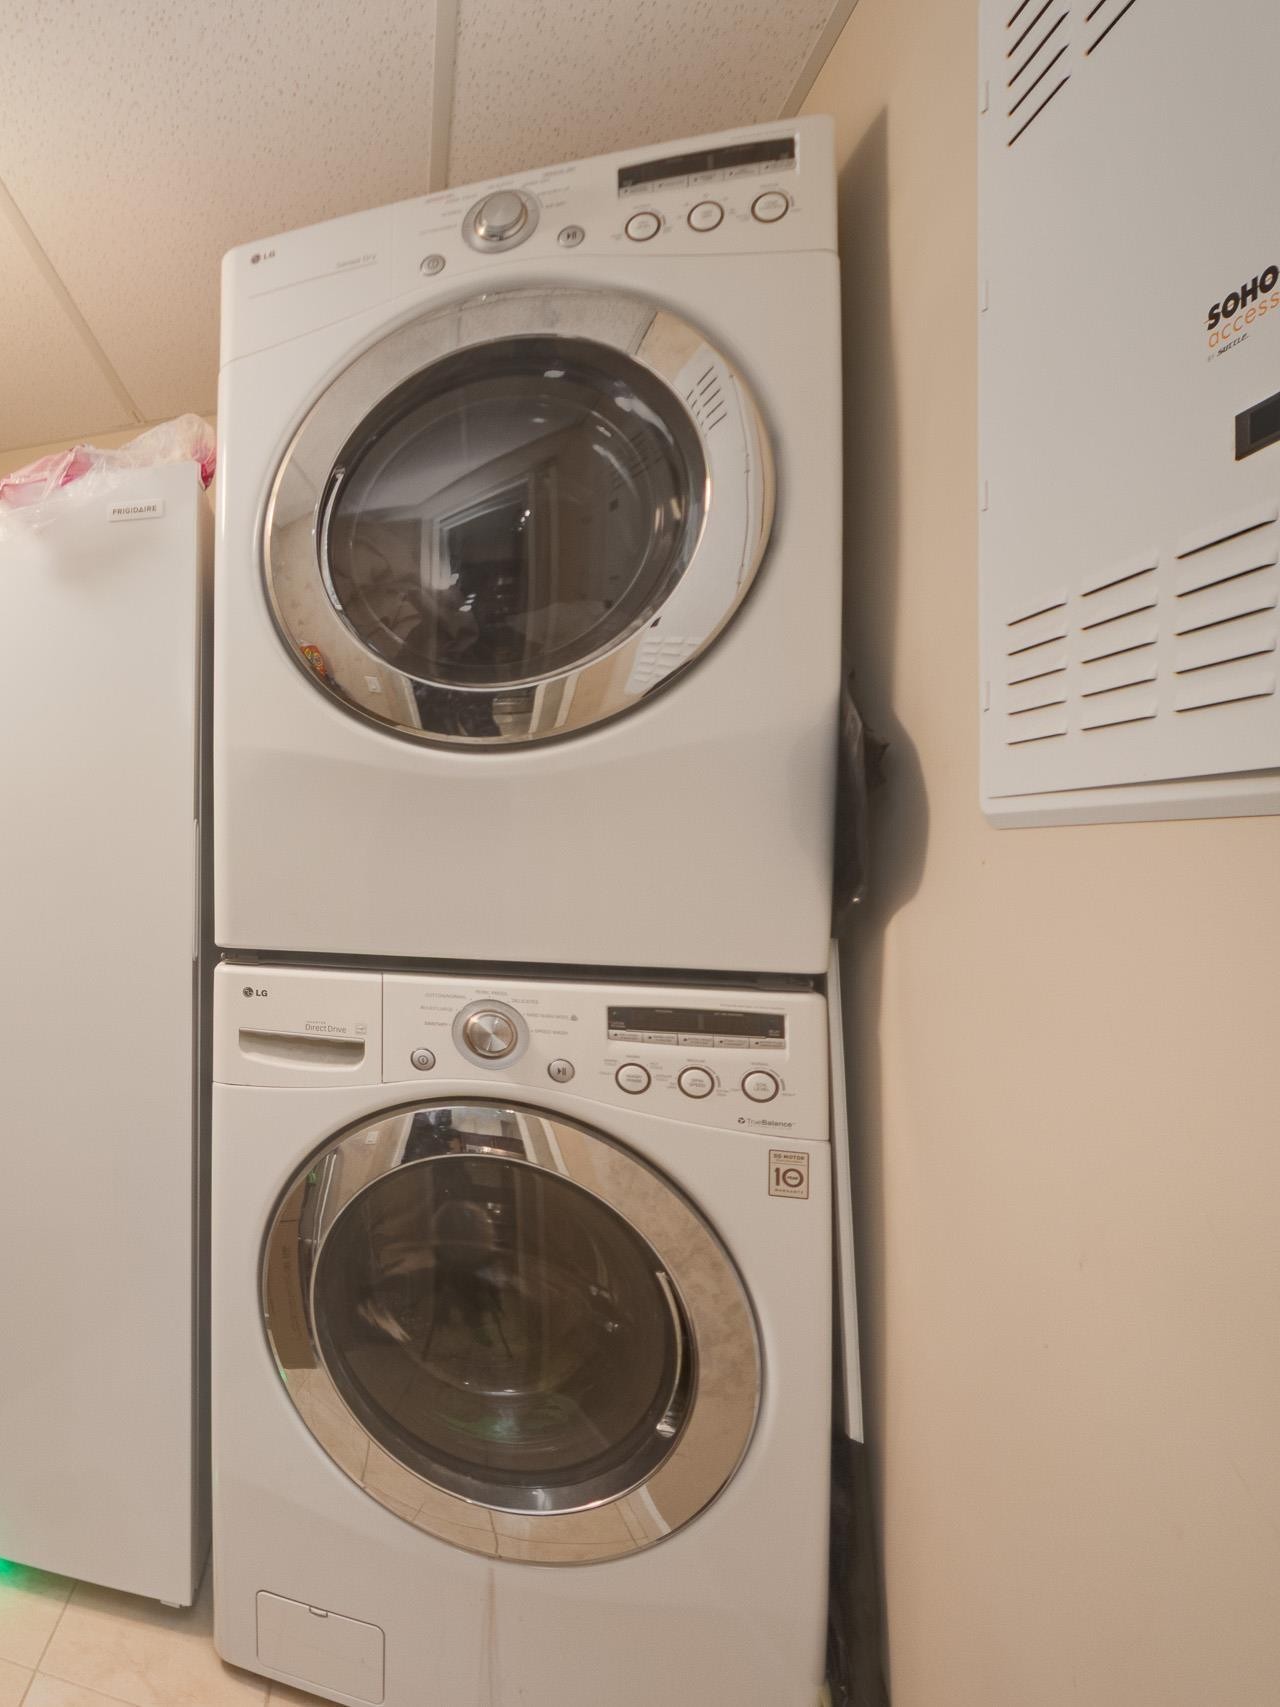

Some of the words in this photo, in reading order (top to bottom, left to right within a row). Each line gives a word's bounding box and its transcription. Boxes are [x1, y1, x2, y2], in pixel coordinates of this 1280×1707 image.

[1207, 265, 1279, 331] SOHO
[1208, 291, 1280, 349] access
[112, 504, 157, 515] FRIGIDAIRE
[305, 1023, 327, 1033] Direct
[327, 1025, 347, 1034] Drive
[774, 1167, 805, 1188] 10
